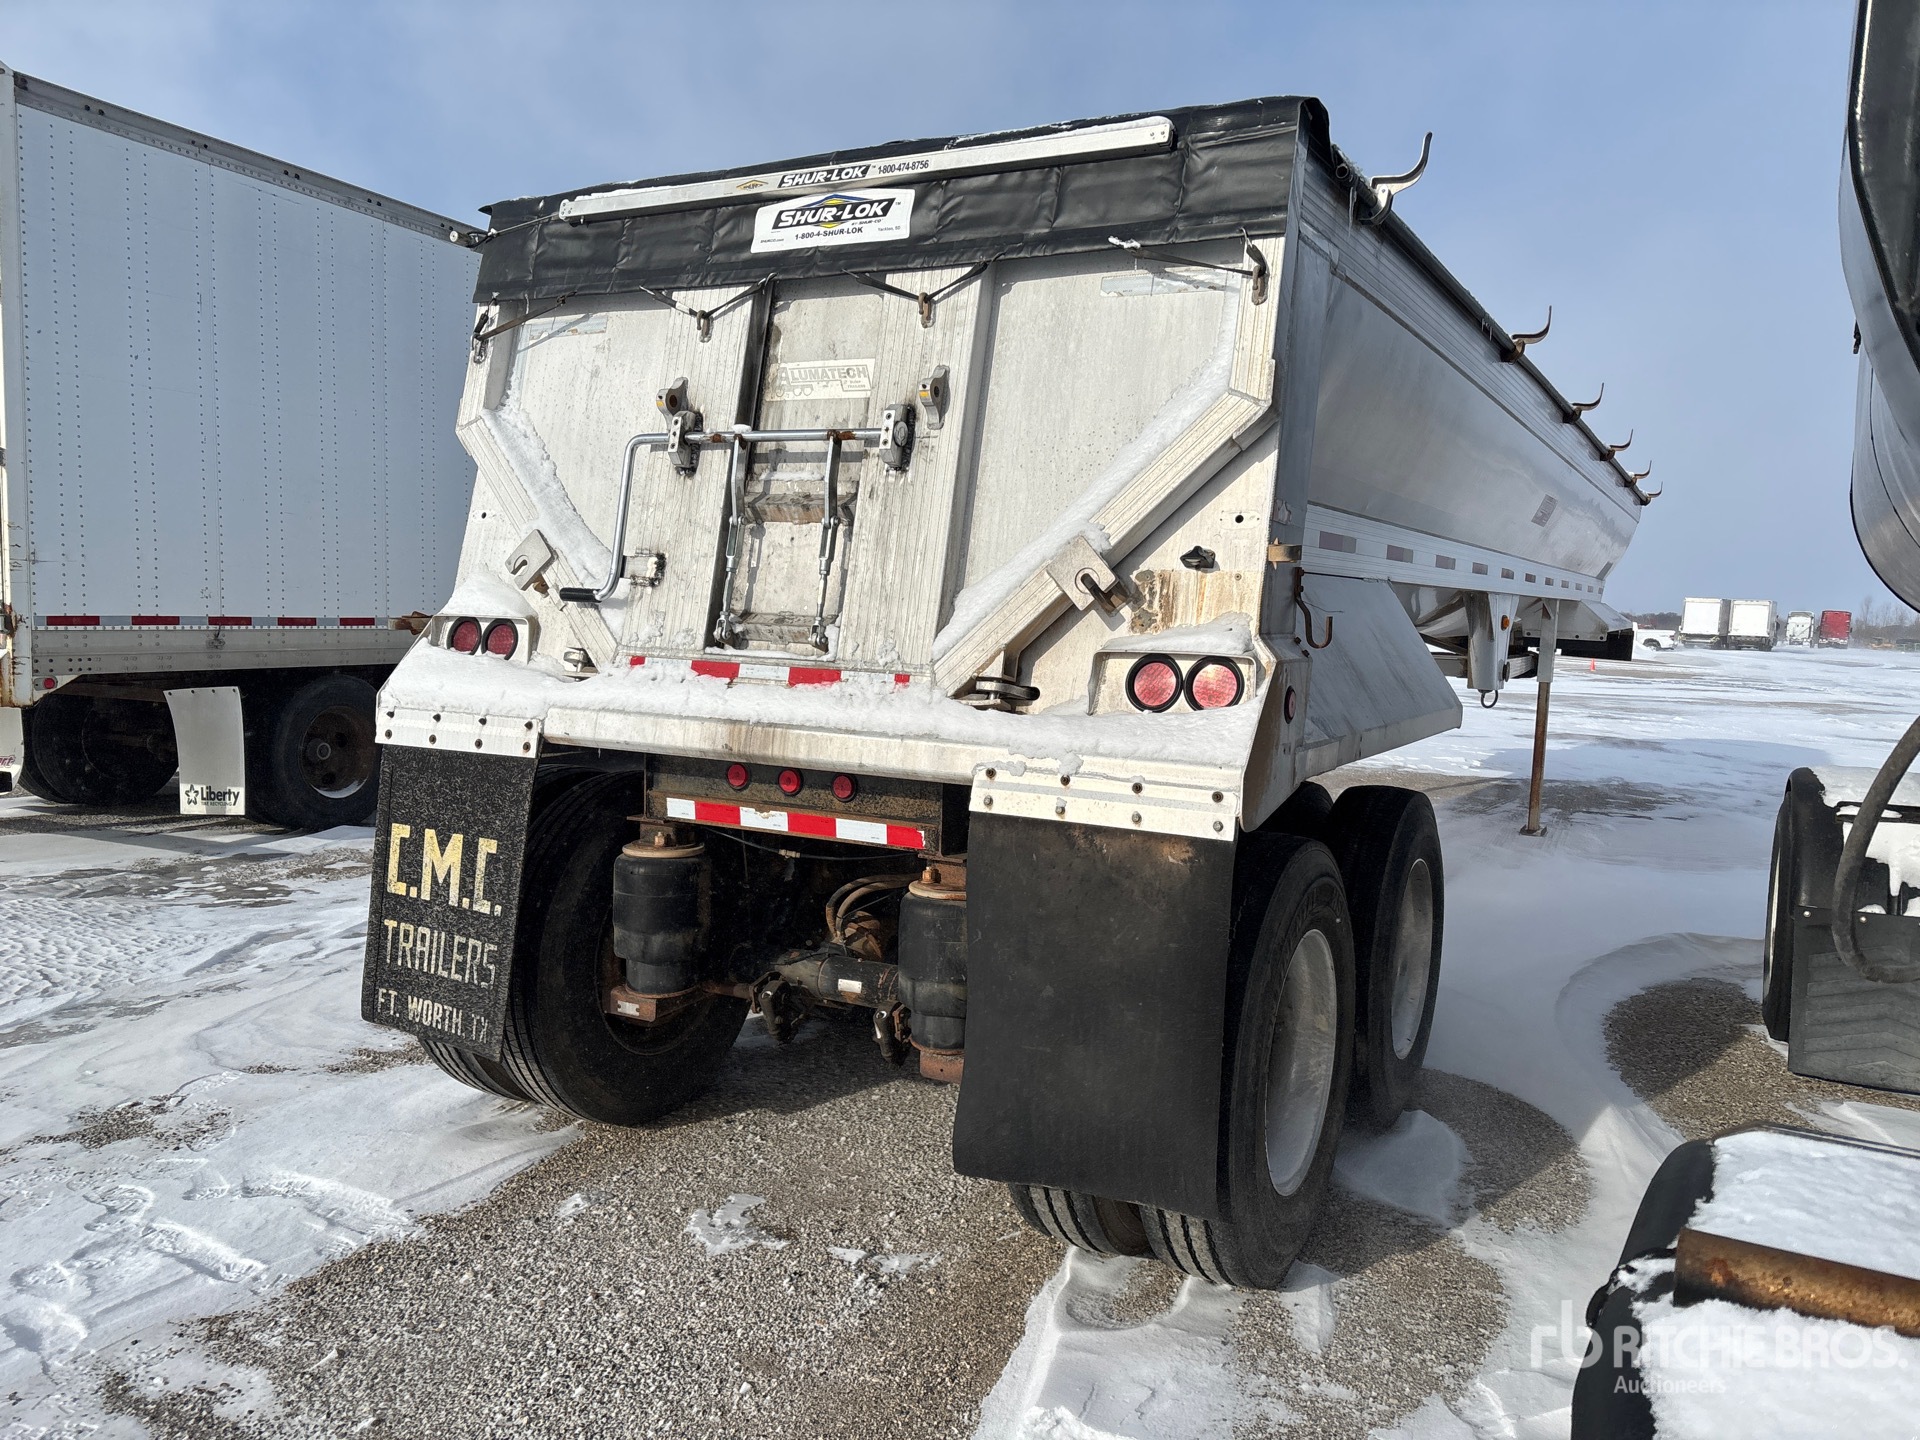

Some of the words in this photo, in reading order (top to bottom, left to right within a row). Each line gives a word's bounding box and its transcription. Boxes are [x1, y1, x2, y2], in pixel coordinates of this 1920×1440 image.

[781, 166, 867, 187] SHUR-LOK
[878, 160, 930, 174] 1-800-474-8756
[778, 201, 889, 227] SHUR-LOK
[795, 226, 863, 240] 1-800-4-SHUR-LOK
[779, 366, 867, 386] ALUMATECH
[201, 786, 240, 806] Liberty
[387, 823, 501, 916] C.M.C.
[384, 919, 498, 990] TRAILERS
[377, 988, 399, 1017] FT.
